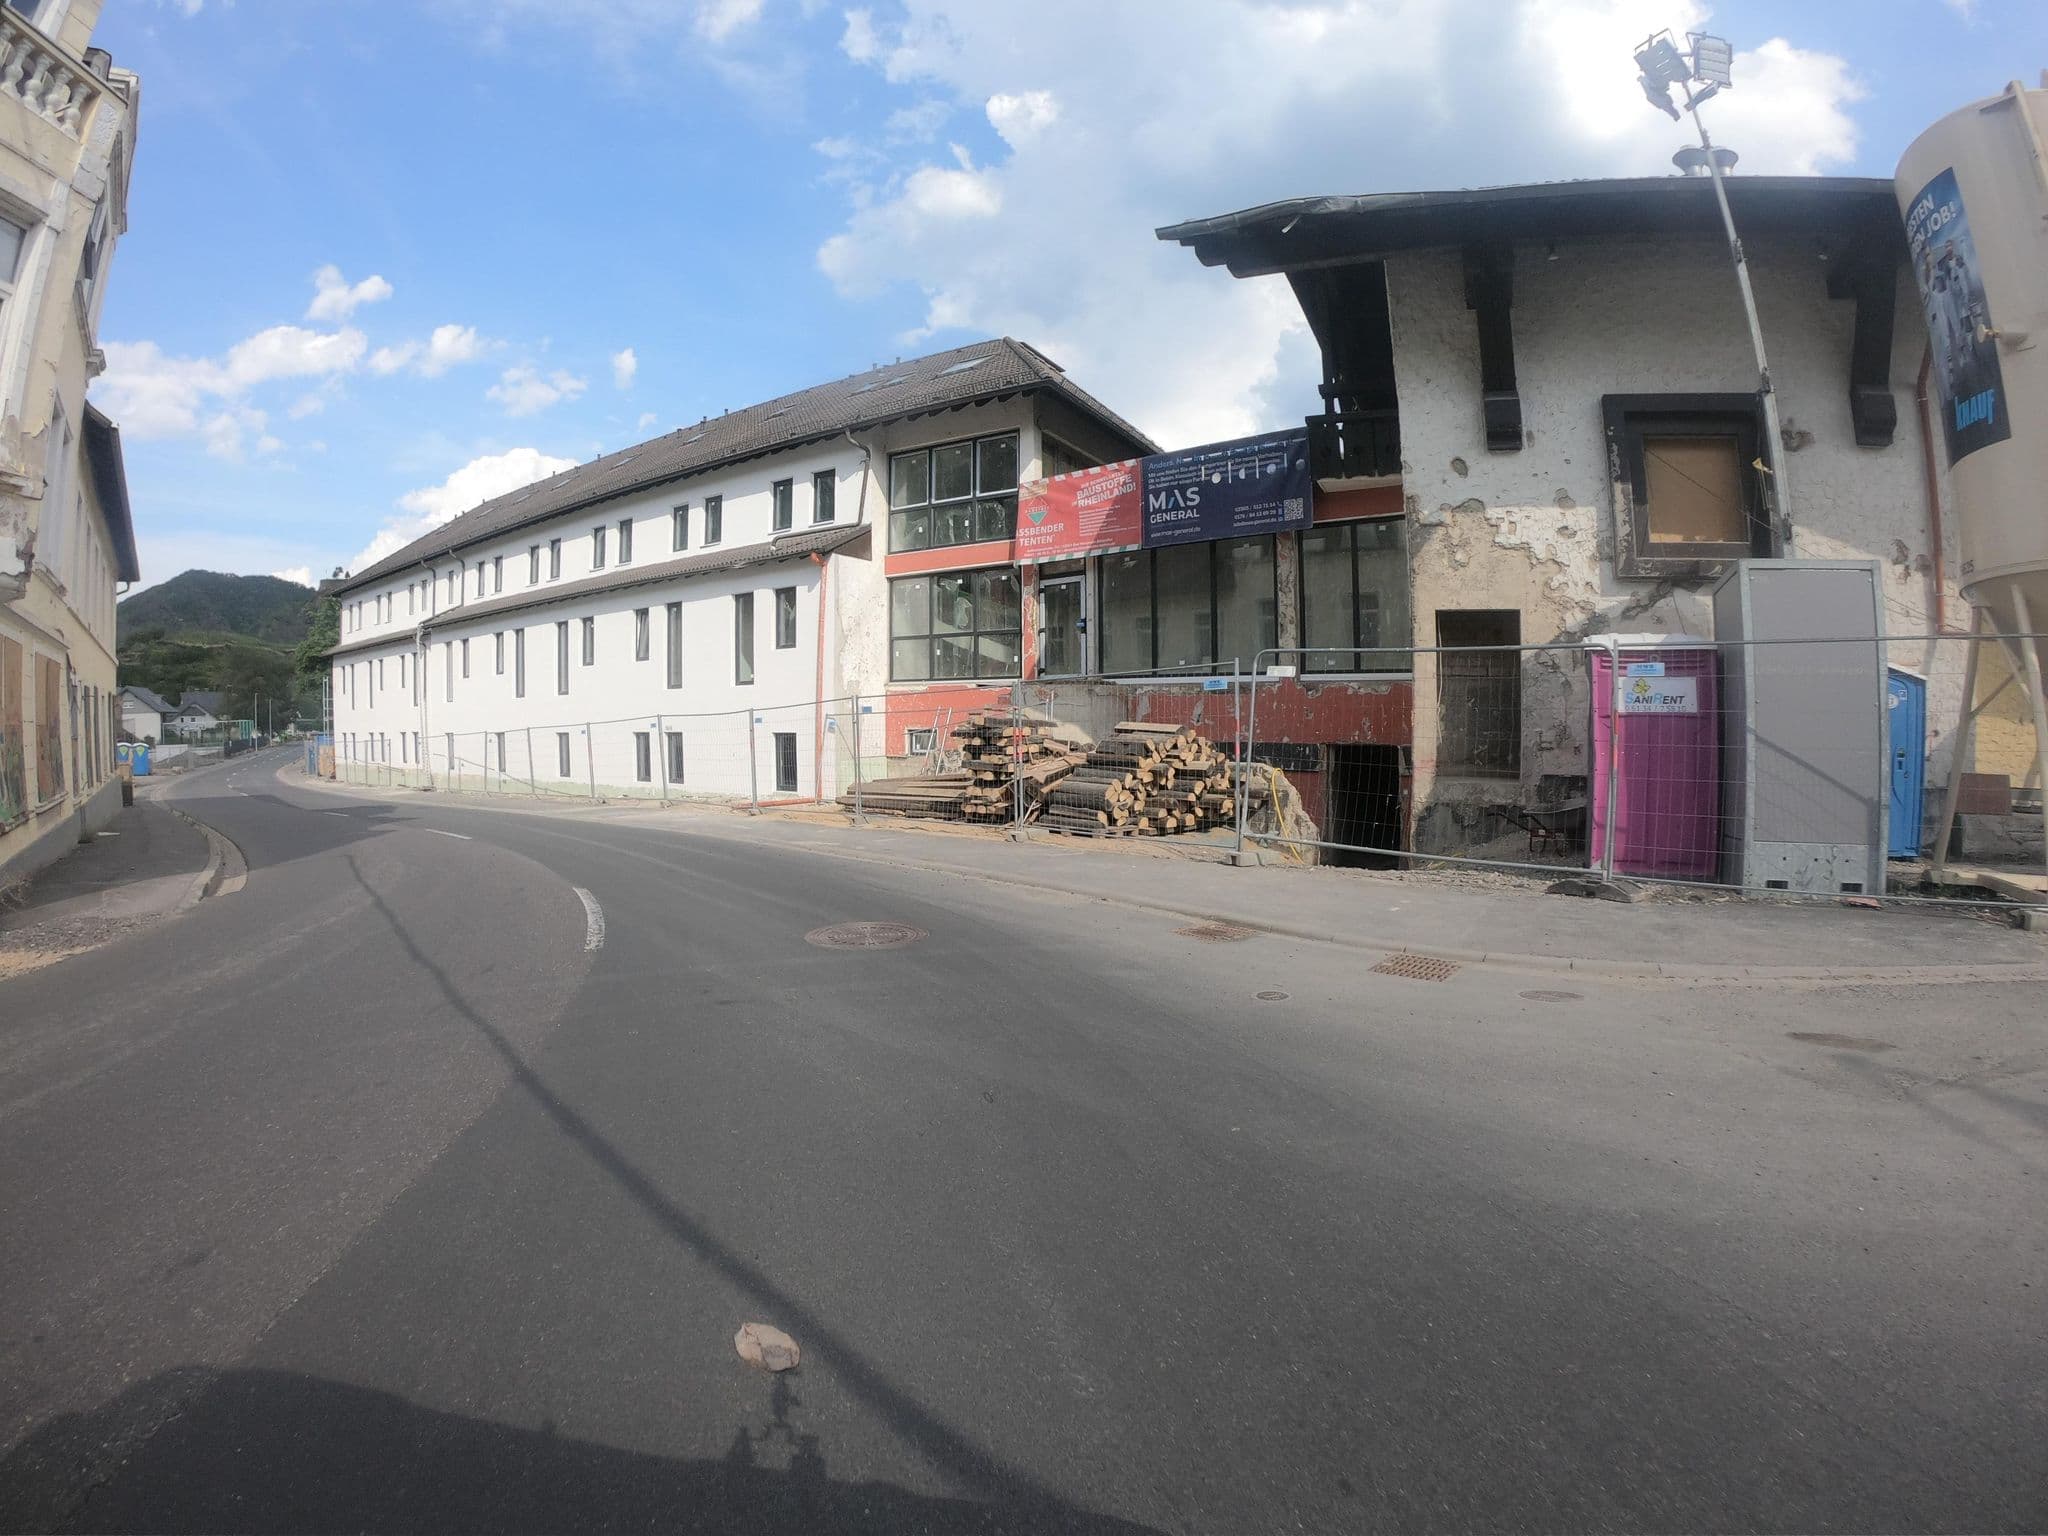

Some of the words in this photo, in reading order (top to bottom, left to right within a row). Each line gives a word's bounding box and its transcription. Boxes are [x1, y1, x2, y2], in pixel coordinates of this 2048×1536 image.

[1077, 474, 1132, 499] BAUSTOFFE
[1078, 482, 1137, 508] RHEINLAND!
[1149, 486, 1201, 512] MAS
[1150, 508, 1200, 524] GENERAL
